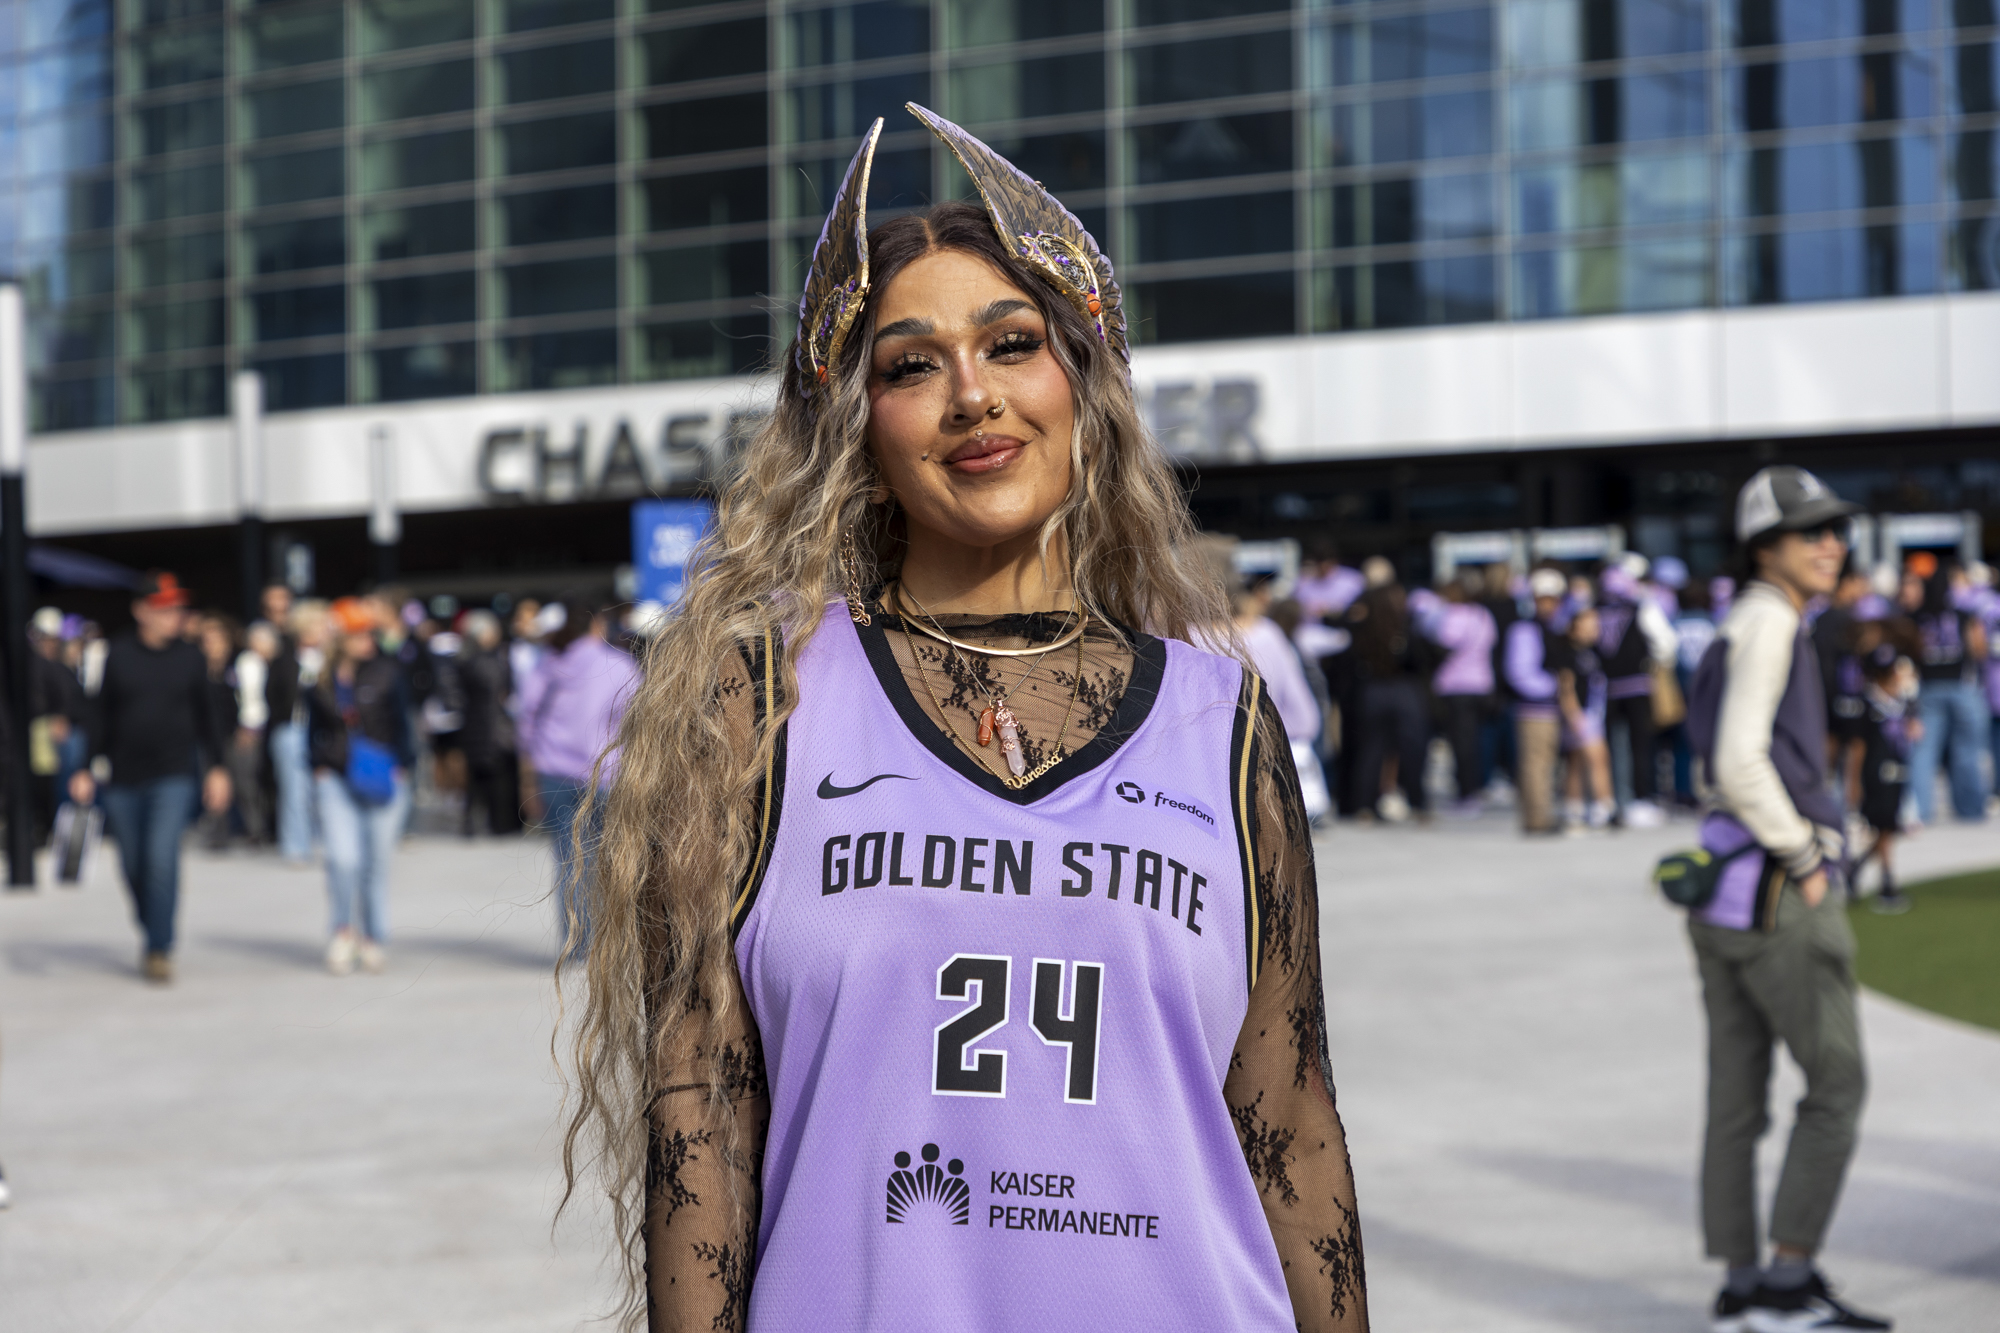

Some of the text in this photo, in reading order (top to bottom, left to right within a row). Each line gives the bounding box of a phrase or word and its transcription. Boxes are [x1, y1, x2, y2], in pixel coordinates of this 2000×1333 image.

[1005, 755, 1063, 788] Vanessa
[1154, 792, 1215, 825] freedom
[822, 832, 1207, 936] GOLDEN STATE
[931, 953, 1104, 1105] 24
[990, 1171, 1075, 1199] KAISER
[989, 1205, 1159, 1239] PERMANENTE
